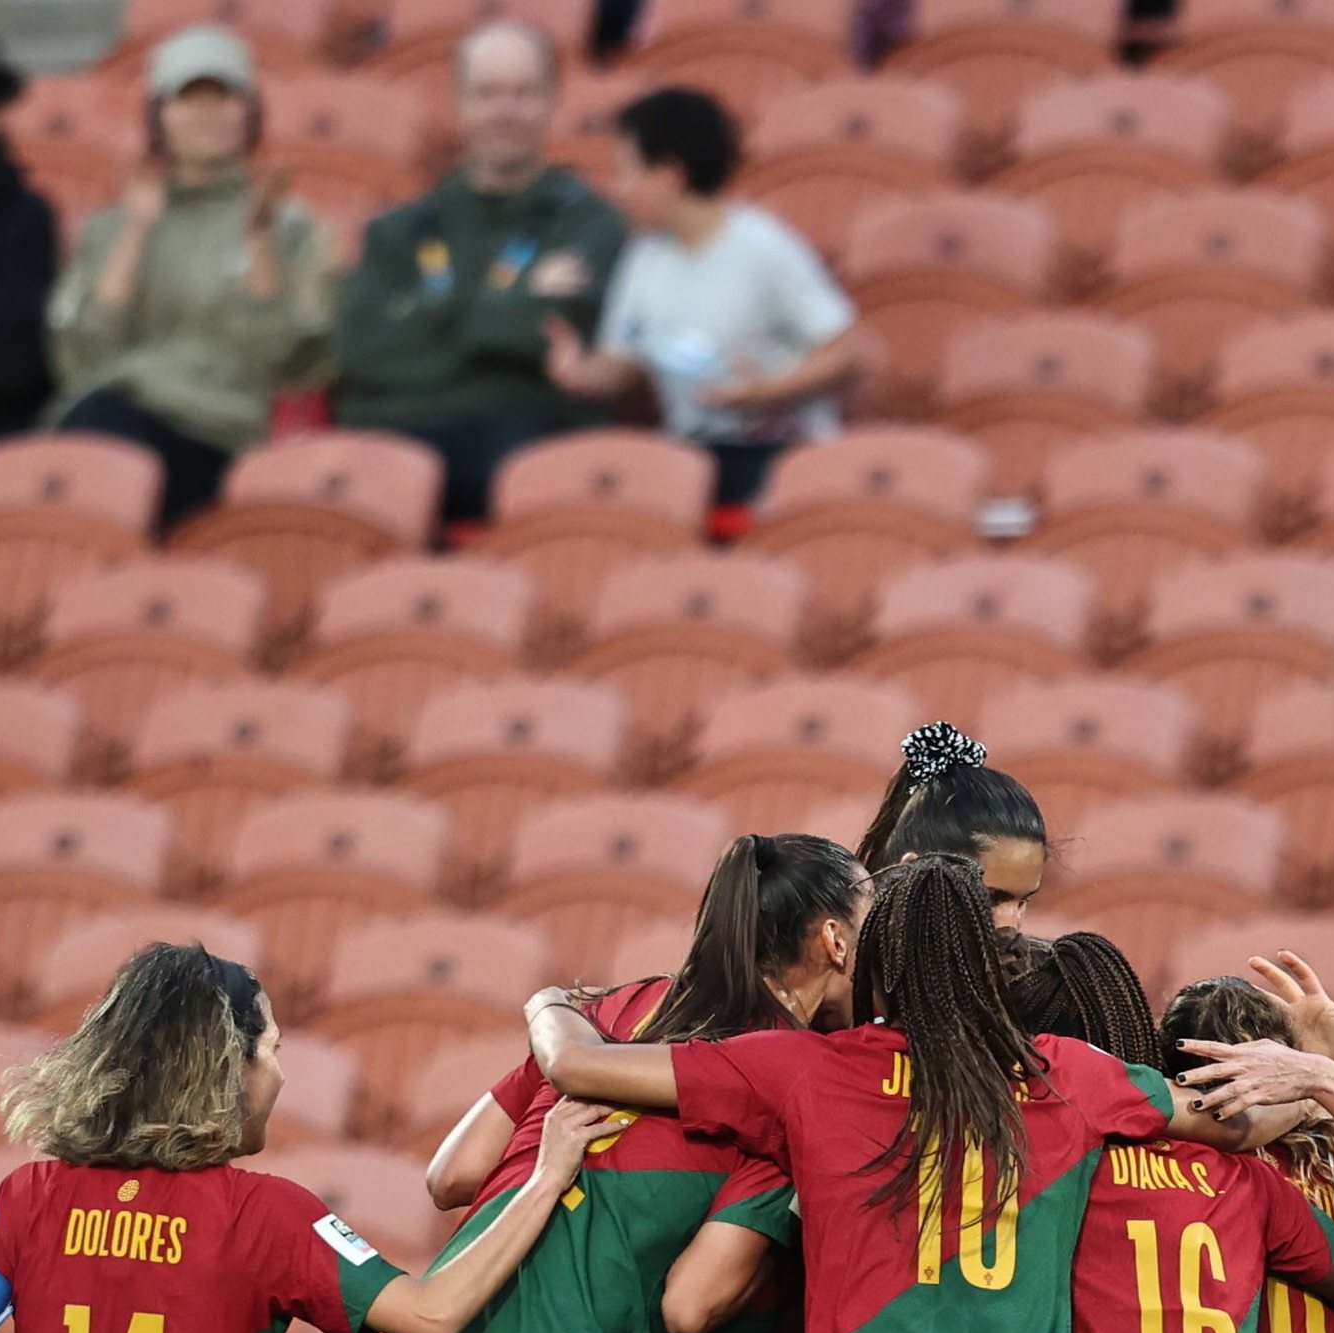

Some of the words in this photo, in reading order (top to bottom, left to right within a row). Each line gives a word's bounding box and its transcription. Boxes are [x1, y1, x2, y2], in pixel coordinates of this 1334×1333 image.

[1109, 1146, 1196, 1193] DIANA
[910, 1111, 1019, 1291] 10
[64, 1208, 187, 1265] DOLORES
